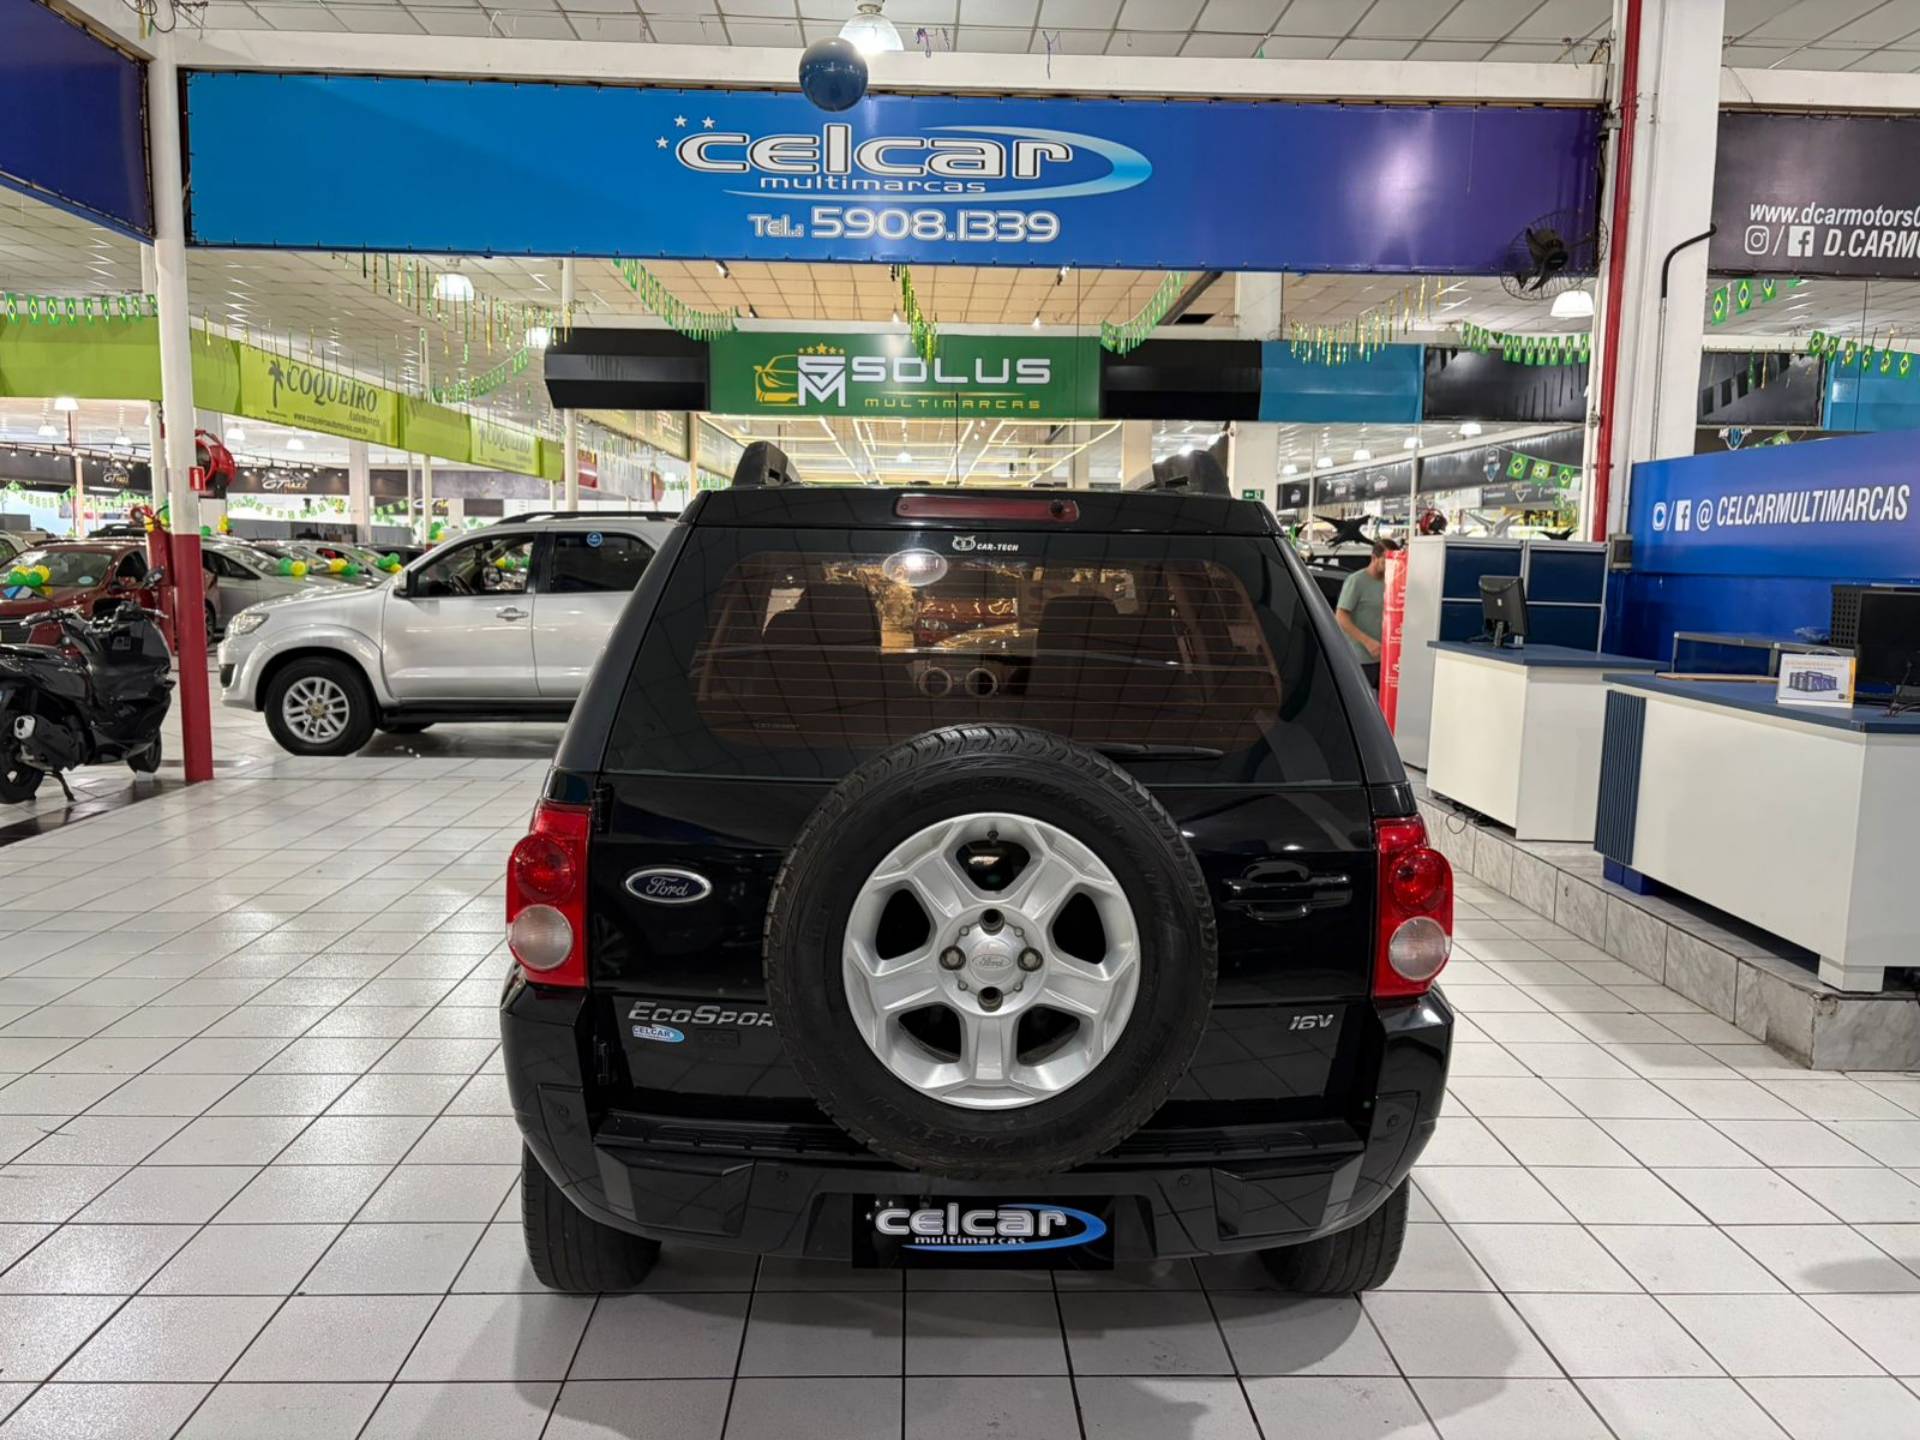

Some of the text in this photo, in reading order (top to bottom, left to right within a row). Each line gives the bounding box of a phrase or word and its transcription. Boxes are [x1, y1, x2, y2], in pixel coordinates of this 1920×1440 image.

[679, 123, 1073, 180] celcar
[760, 175, 986, 193] multimarcas
[811, 206, 1060, 244] 5908.1339
[1823, 229, 1920, 258] D.CARM
[851, 356, 1051, 384] SOLUS
[286, 365, 378, 413] COQUEIRO
[864, 397, 1041, 410] MULTIMARCAS
[1716, 484, 1910, 527] CELCARMULTIMARCAS
[976, 542, 1020, 552] CAR-TECH
[645, 874, 690, 897] Ford
[1289, 1014, 1334, 1030] 16V
[875, 1202, 1067, 1237] celcar
[914, 1234, 1026, 1246] multimarcas
